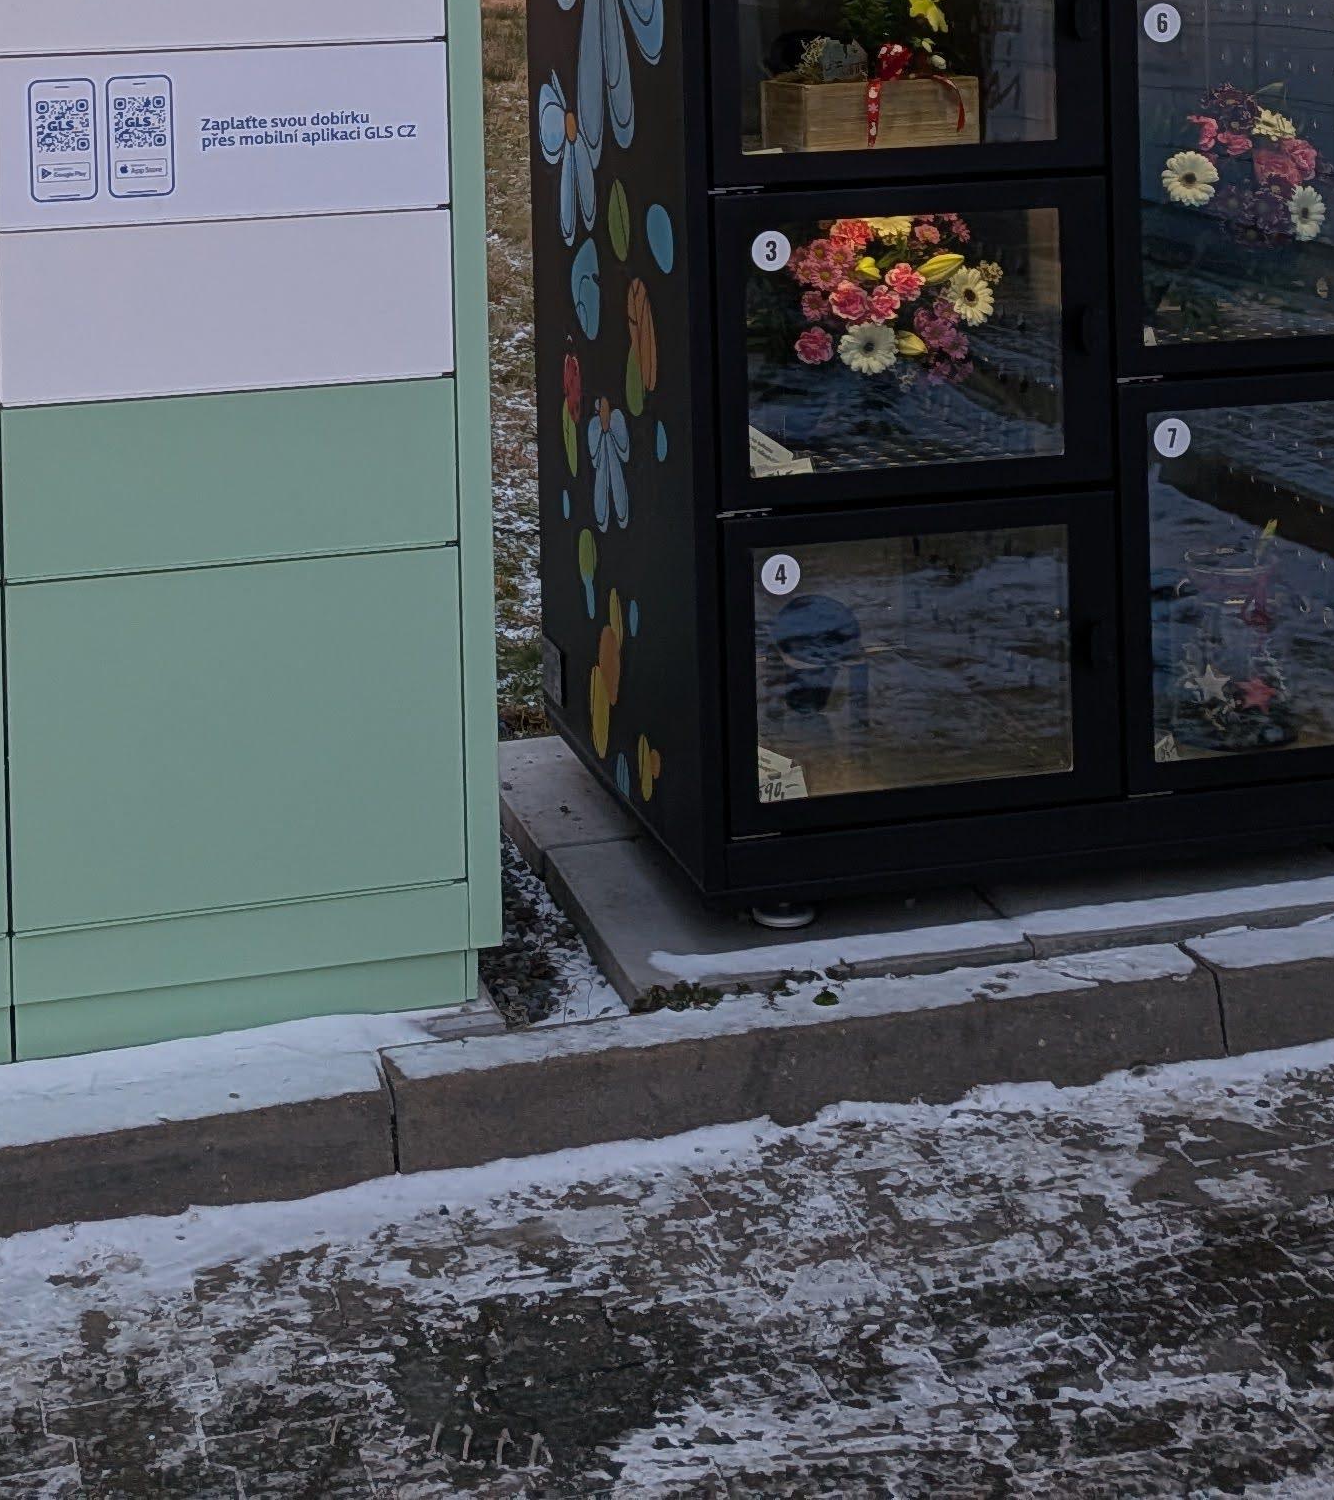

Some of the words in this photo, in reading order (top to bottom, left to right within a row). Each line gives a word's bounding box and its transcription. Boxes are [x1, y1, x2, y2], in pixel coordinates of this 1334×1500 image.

[1156, 12, 1168, 34] 6
[201, 115, 268, 134] Zaplaťte
[270, 115, 307, 129] svou
[310, 110, 370, 126] dobírku
[202, 133, 236, 150] přes
[239, 130, 299, 146] mobilní
[301, 127, 361, 146] aplikaci
[364, 125, 394, 139] GLS
[397, 124, 417, 138] CZ
[765, 240, 777, 262] 3
[1167, 427, 1178, 449] 7
[774, 563, 788, 585] 4
